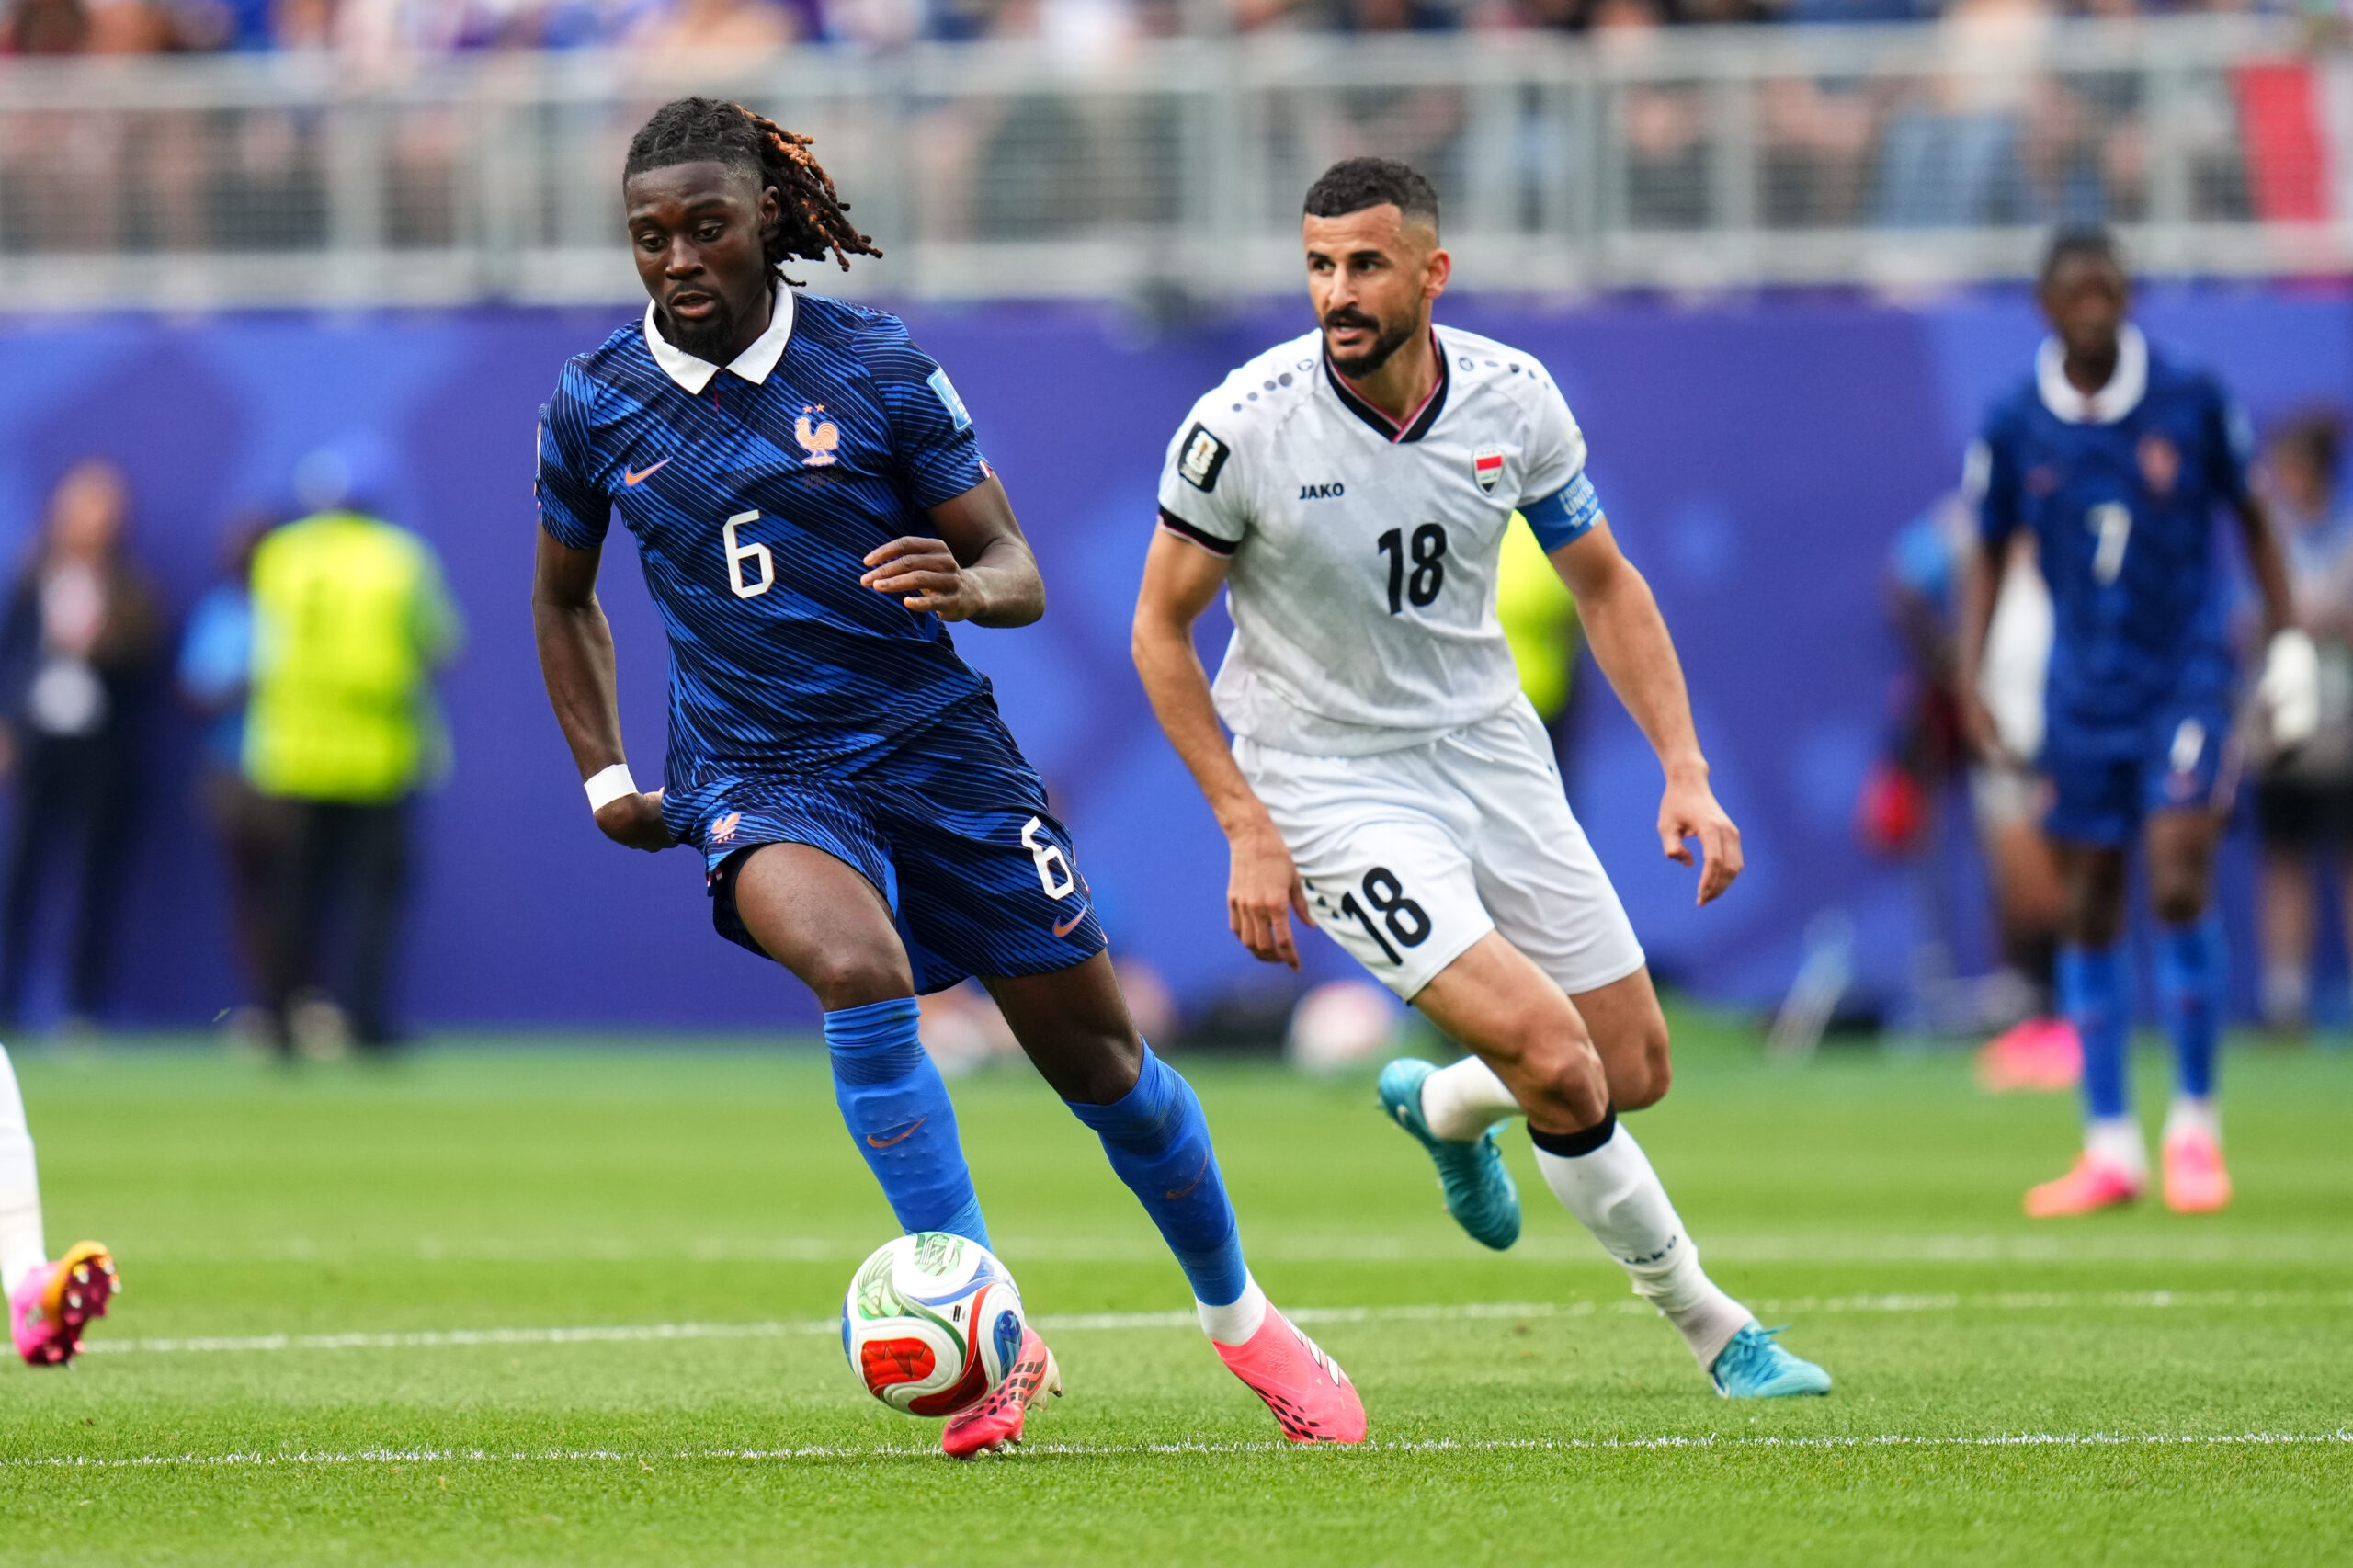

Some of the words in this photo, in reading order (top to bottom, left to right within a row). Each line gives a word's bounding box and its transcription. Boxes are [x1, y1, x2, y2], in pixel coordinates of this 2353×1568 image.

[1298, 483, 1345, 500] JAKO
[722, 509, 774, 599] 6
[1377, 522, 1448, 617] 18
[2090, 503, 2131, 585] 7
[1020, 815, 1074, 901] 6
[1340, 867, 1431, 967] 18
